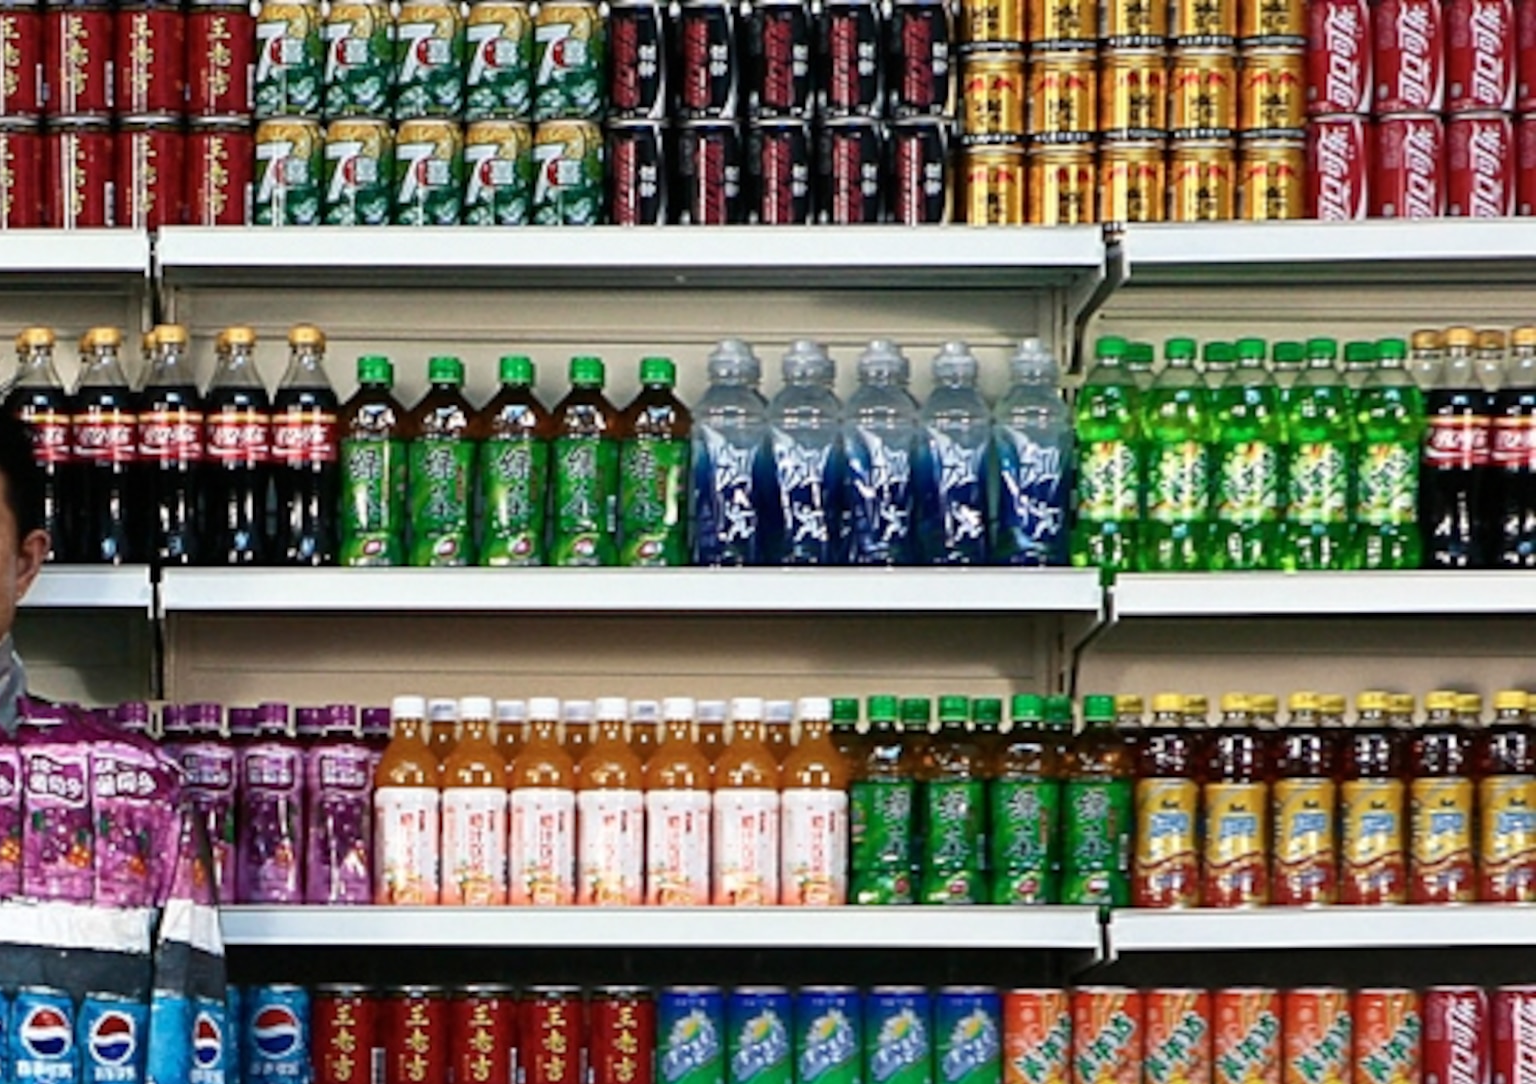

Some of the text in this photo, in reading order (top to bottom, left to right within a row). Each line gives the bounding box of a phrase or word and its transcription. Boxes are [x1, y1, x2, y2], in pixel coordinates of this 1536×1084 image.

[331, 1003, 355, 1082] 王老吉
[404, 1003, 429, 1082] 王老吉
[468, 1003, 494, 1082] 王老吉
[542, 1003, 566, 1082] 王老吉
[613, 1003, 637, 1082] 王老吉
